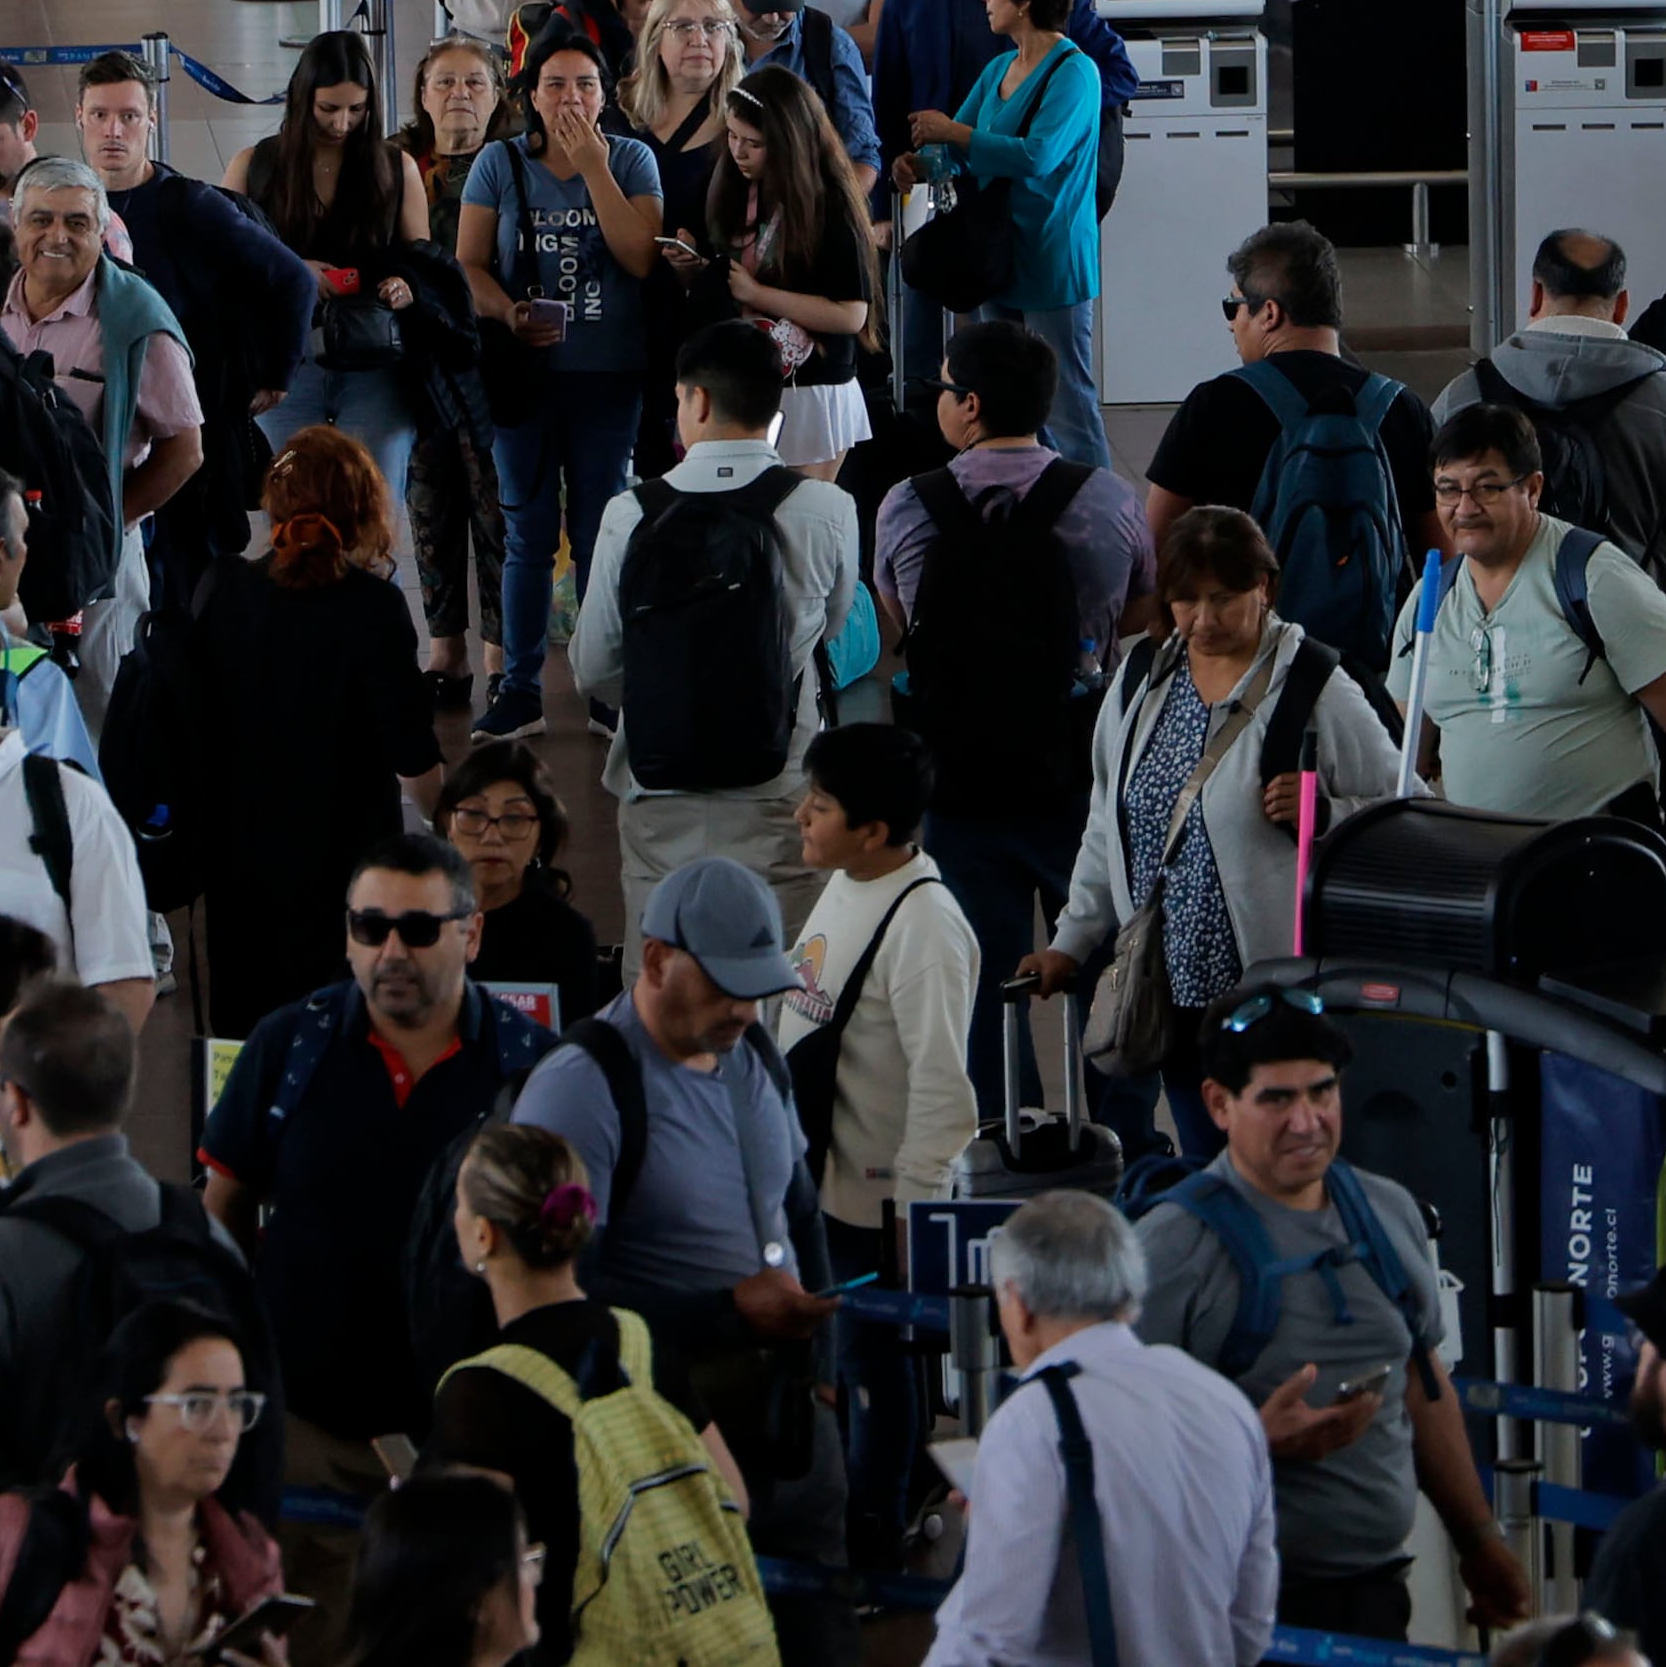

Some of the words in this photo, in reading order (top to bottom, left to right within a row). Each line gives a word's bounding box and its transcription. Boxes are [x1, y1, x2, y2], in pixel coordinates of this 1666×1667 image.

[1568, 1163, 1593, 1287] NORTE
[657, 1540, 714, 1583] GIRL
[665, 1563, 746, 1615] POWER
